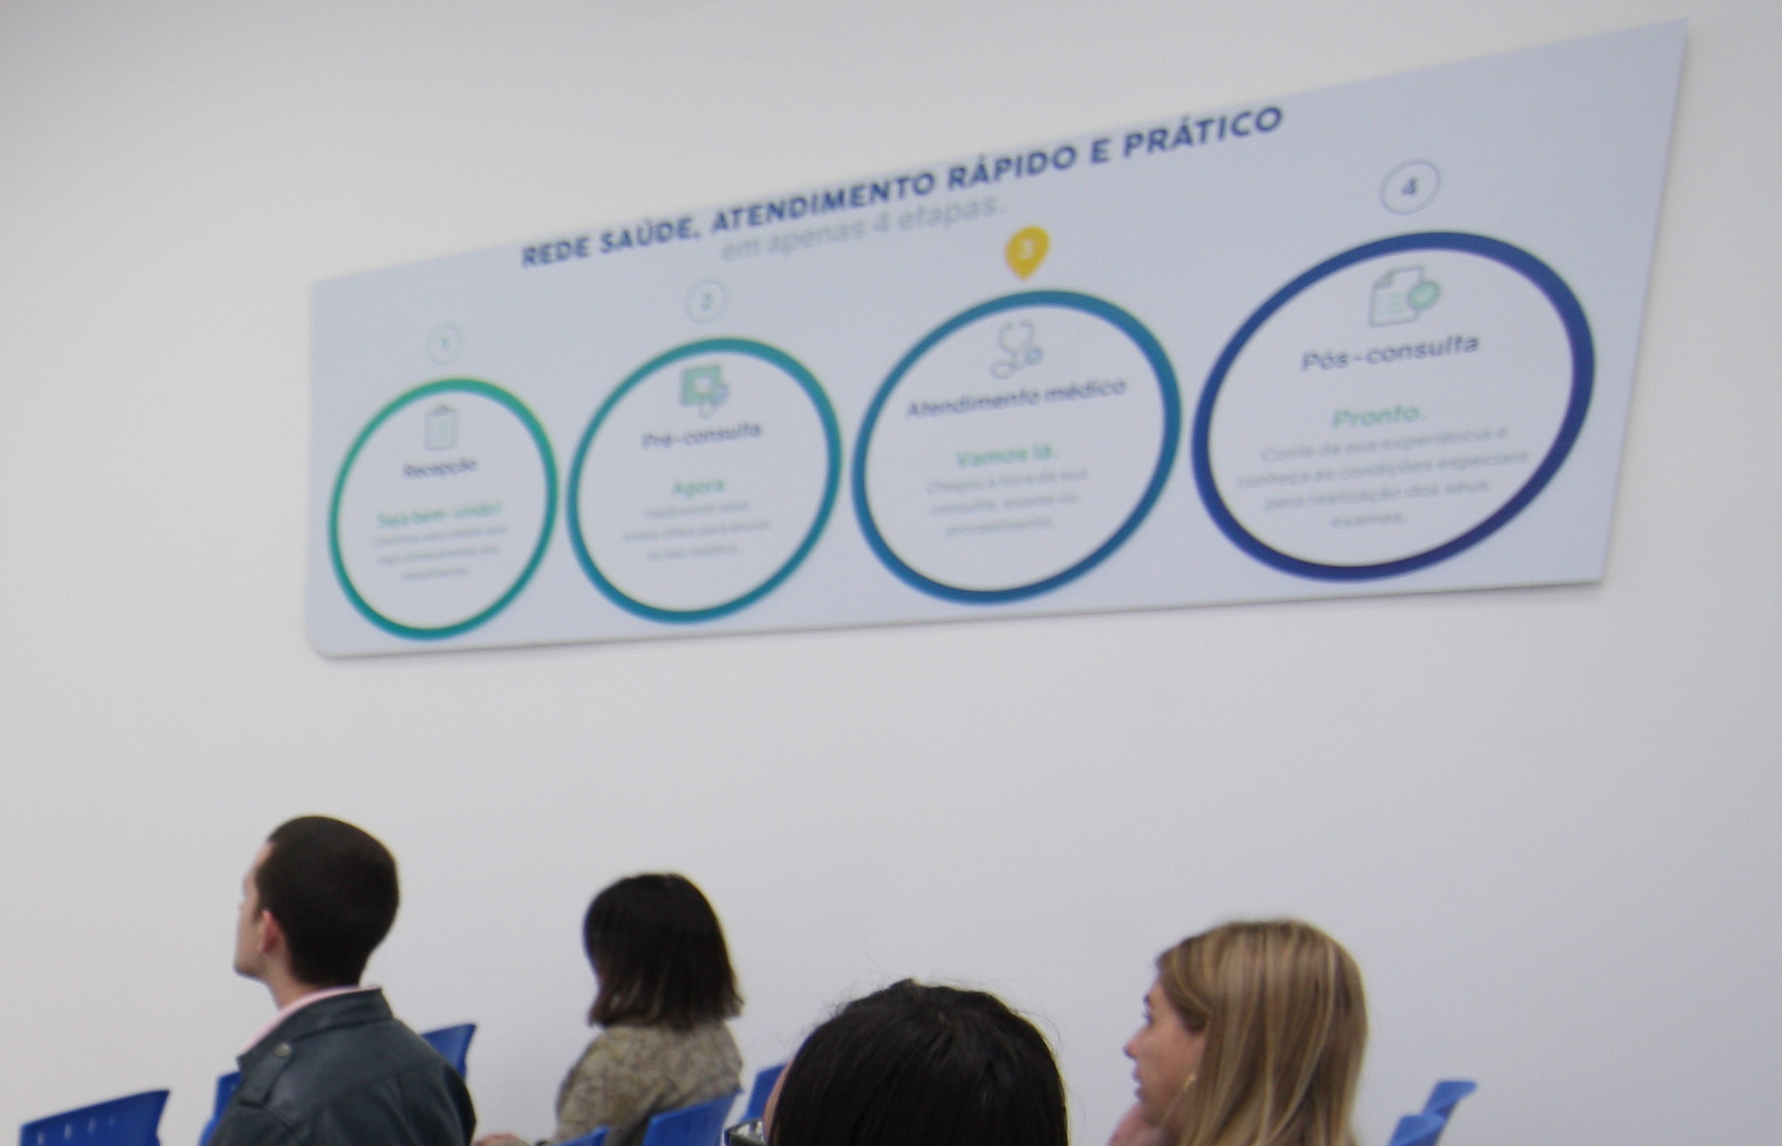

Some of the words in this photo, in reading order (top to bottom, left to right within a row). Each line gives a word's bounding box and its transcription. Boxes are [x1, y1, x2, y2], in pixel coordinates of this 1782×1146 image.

[521, 235, 590, 267] REDE
[599, 215, 702, 254] SAÚDE,
[710, 172, 935, 234] ATENDIMENTO
[947, 145, 1078, 191] RÁPIDO
[1090, 137, 1112, 165] E
[1123, 106, 1283, 158] PRÁTICO
[1401, 177, 1417, 196] 4
[721, 240, 761, 263] em
[765, 219, 866, 256] apenas
[873, 208, 890, 232] 4
[896, 196, 1006, 231] etapas.
[1300, 334, 1481, 373] Pós-consulta
[905, 388, 1041, 419] Atendimento
[1044, 377, 1127, 401] médico
[1331, 403, 1428, 430] Pronto.
[641, 422, 763, 449] Pré-consulta
[956, 447, 1028, 468] Vamos
